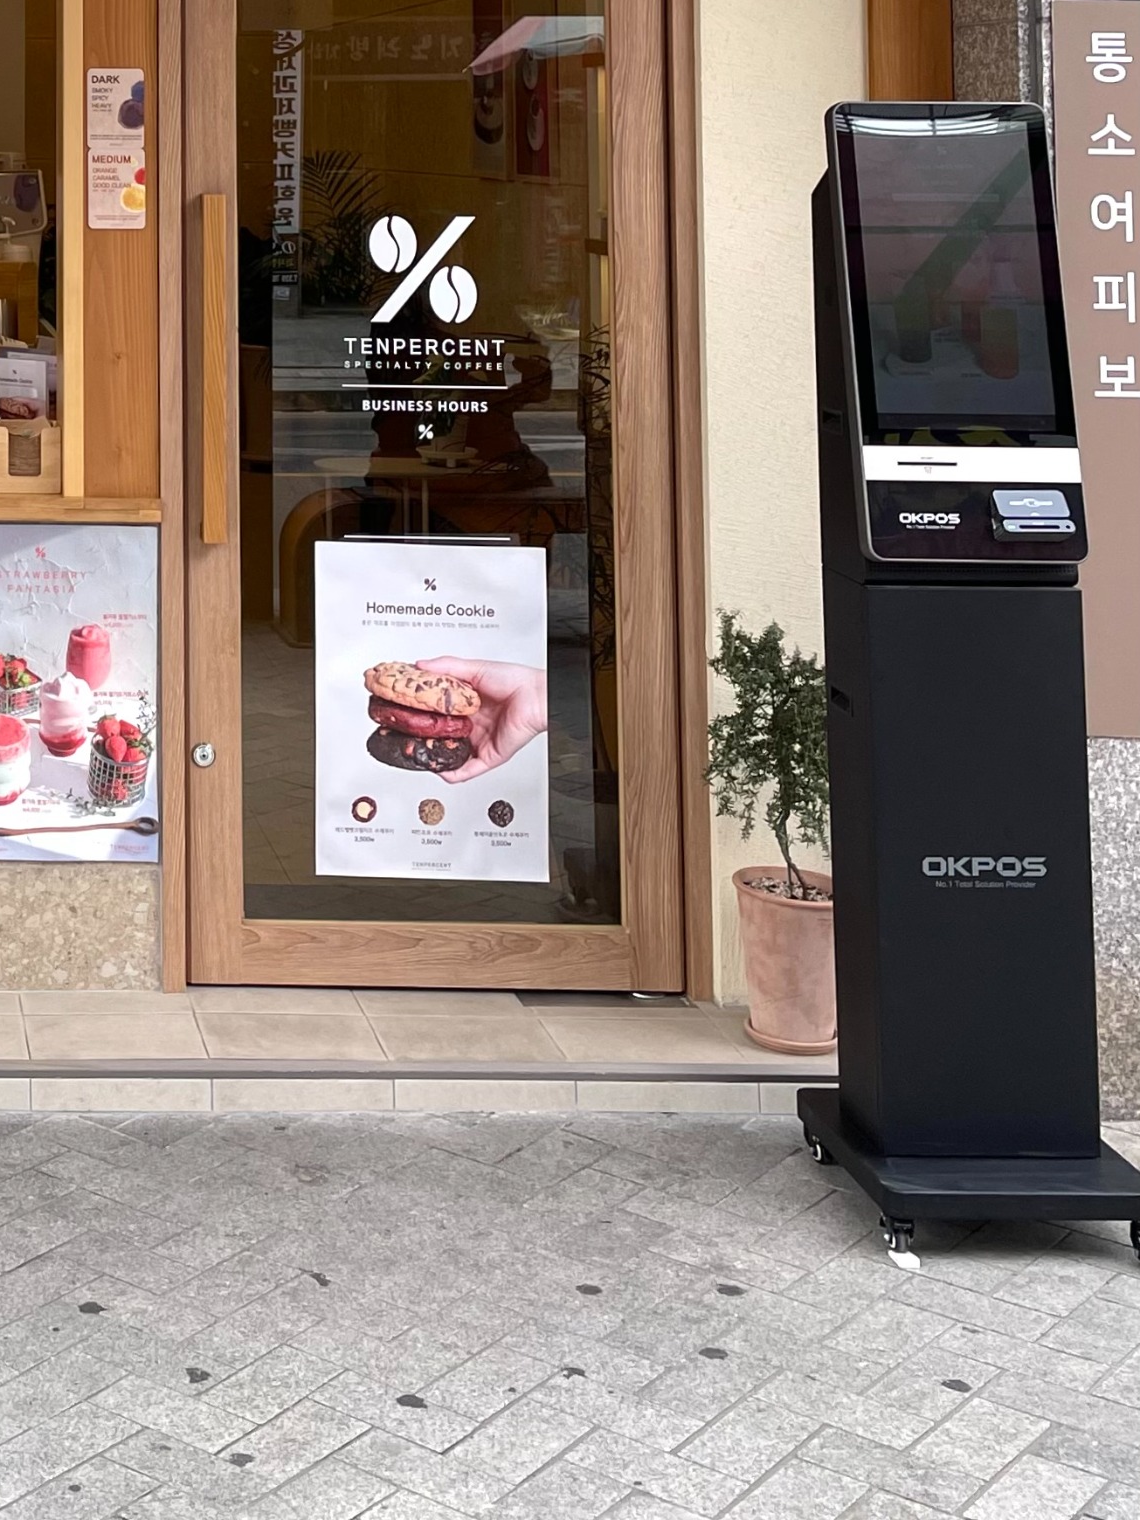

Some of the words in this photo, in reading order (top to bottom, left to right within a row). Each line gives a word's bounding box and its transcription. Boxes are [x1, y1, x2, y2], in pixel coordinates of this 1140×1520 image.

[1086, 32, 1134, 83] 통
[91, 75, 120, 84] DARK
[1088, 113, 1136, 156] 소
[92, 155, 132, 164] MEDIUM
[1090, 191, 1134, 243] 여
[1093, 271, 1137, 324] 피
[344, 338, 505, 356] TENPERCENT
[344, 360, 432, 370] SPECIALTY
[444, 362, 503, 371] COFFEE
[362, 400, 433, 411] BUSINESS
[438, 400, 488, 412] HOURS
[899, 512, 960, 525] OKPOS
[7, 585, 76, 594] FANTASIA
[366, 602, 442, 616] Homemade
[446, 604, 495, 617] Cookie
[922, 856, 1047, 877] OKPOS
[935, 880, 953, 888] No.1
[956, 880, 973, 888] Total
[975, 880, 1004, 888] Solution
[1006, 880, 1036, 888] Provider
